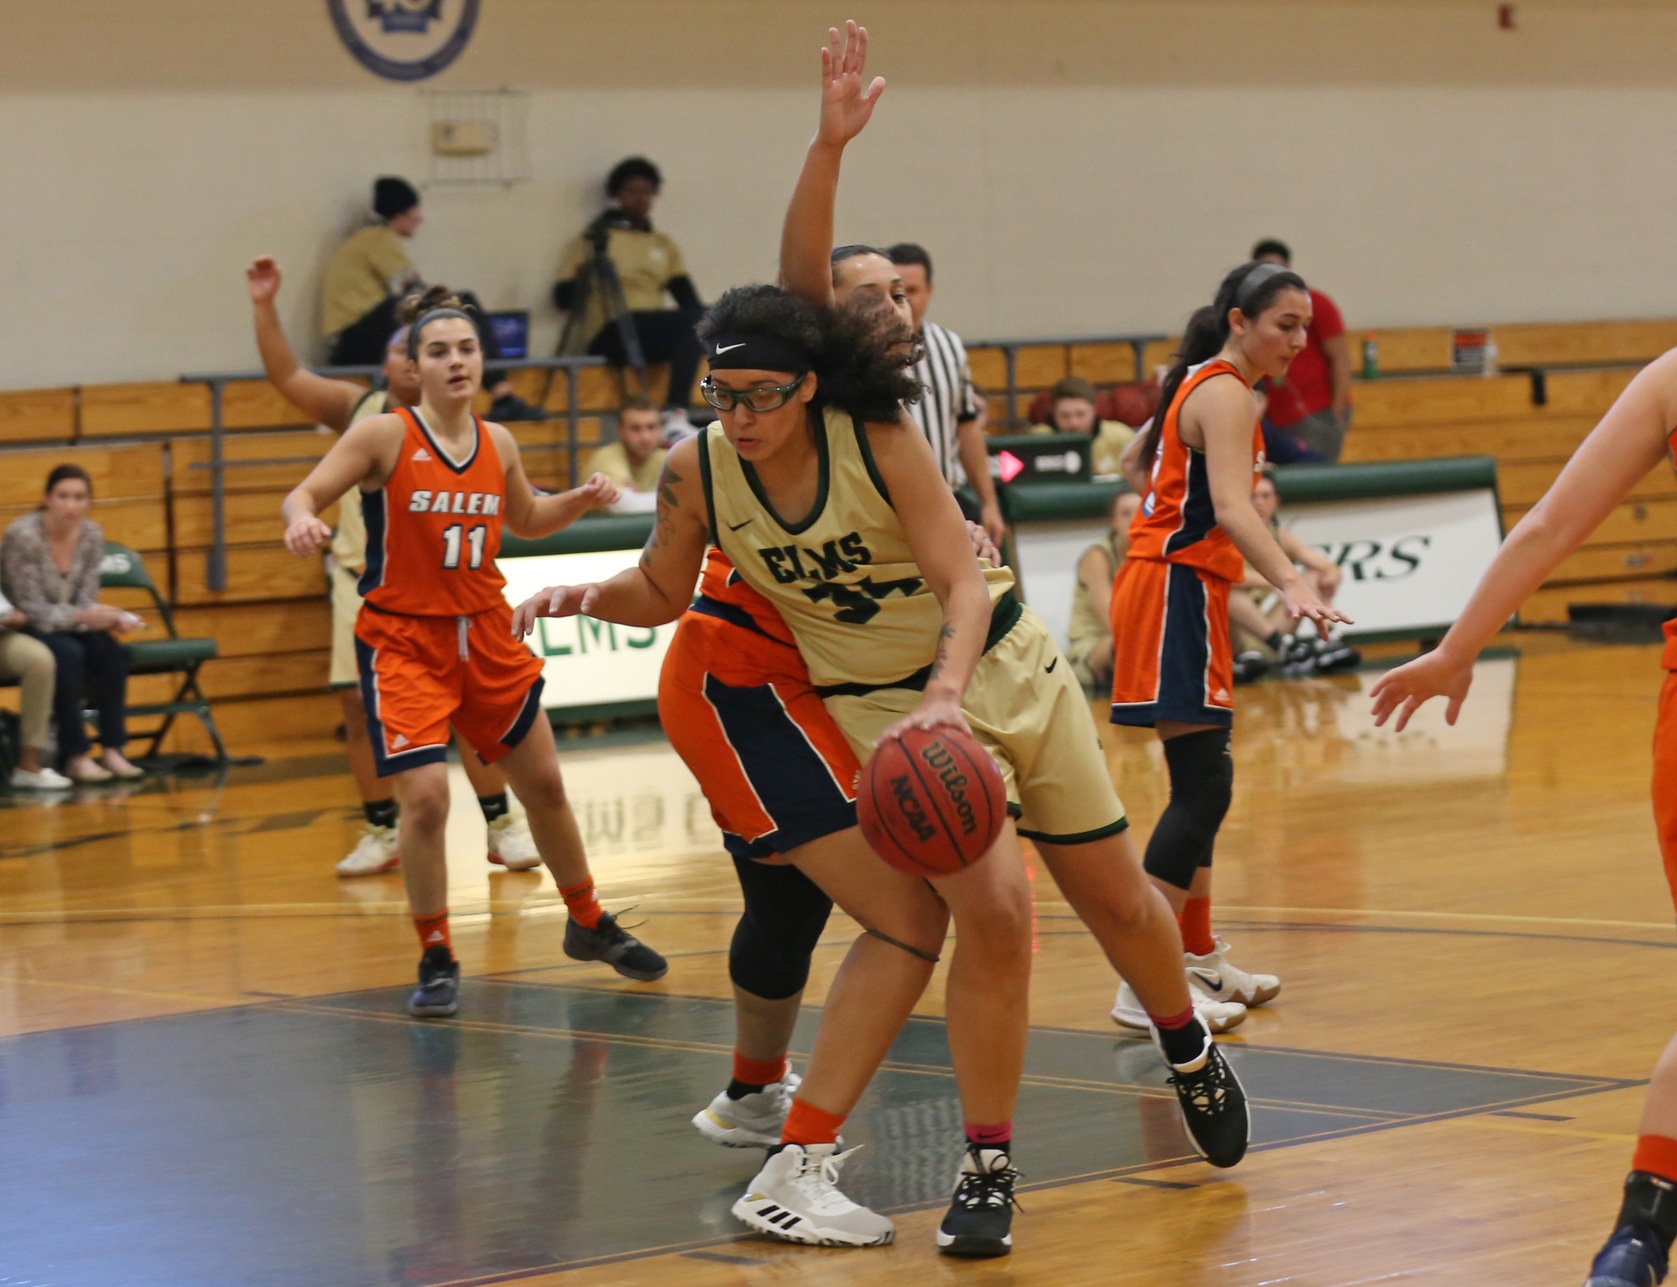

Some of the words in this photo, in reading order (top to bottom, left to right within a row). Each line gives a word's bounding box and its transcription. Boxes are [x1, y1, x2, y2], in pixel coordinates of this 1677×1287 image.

[408, 490, 501, 516] SALEM
[442, 523, 487, 570] 11
[758, 531, 872, 584] ELMS
[1309, 534, 1432, 582] RS
[538, 612, 658, 657] LMS
[890, 774, 938, 843] NCAA
[921, 741, 978, 836] Wilson
